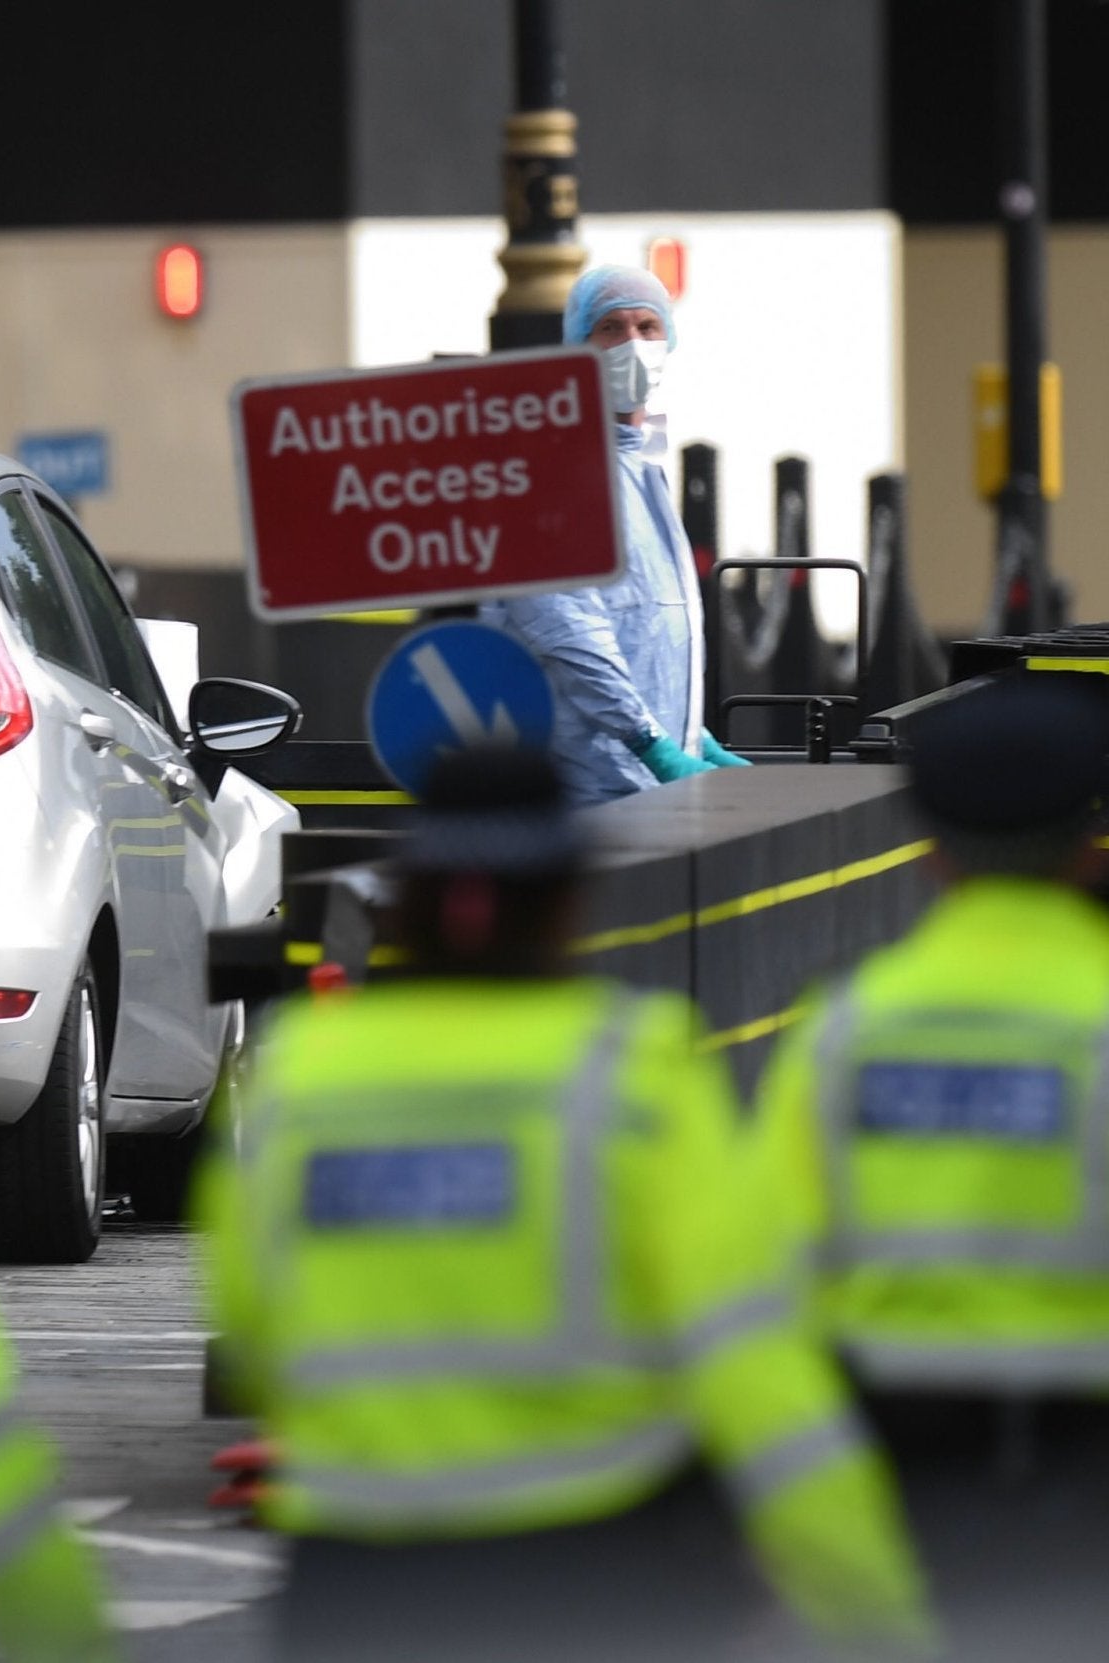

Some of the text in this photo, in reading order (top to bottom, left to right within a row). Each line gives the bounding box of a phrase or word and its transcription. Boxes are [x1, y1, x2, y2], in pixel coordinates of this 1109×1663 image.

[269, 377, 581, 457] Authorised
[331, 458, 531, 515] Access
[368, 516, 501, 573] Only
